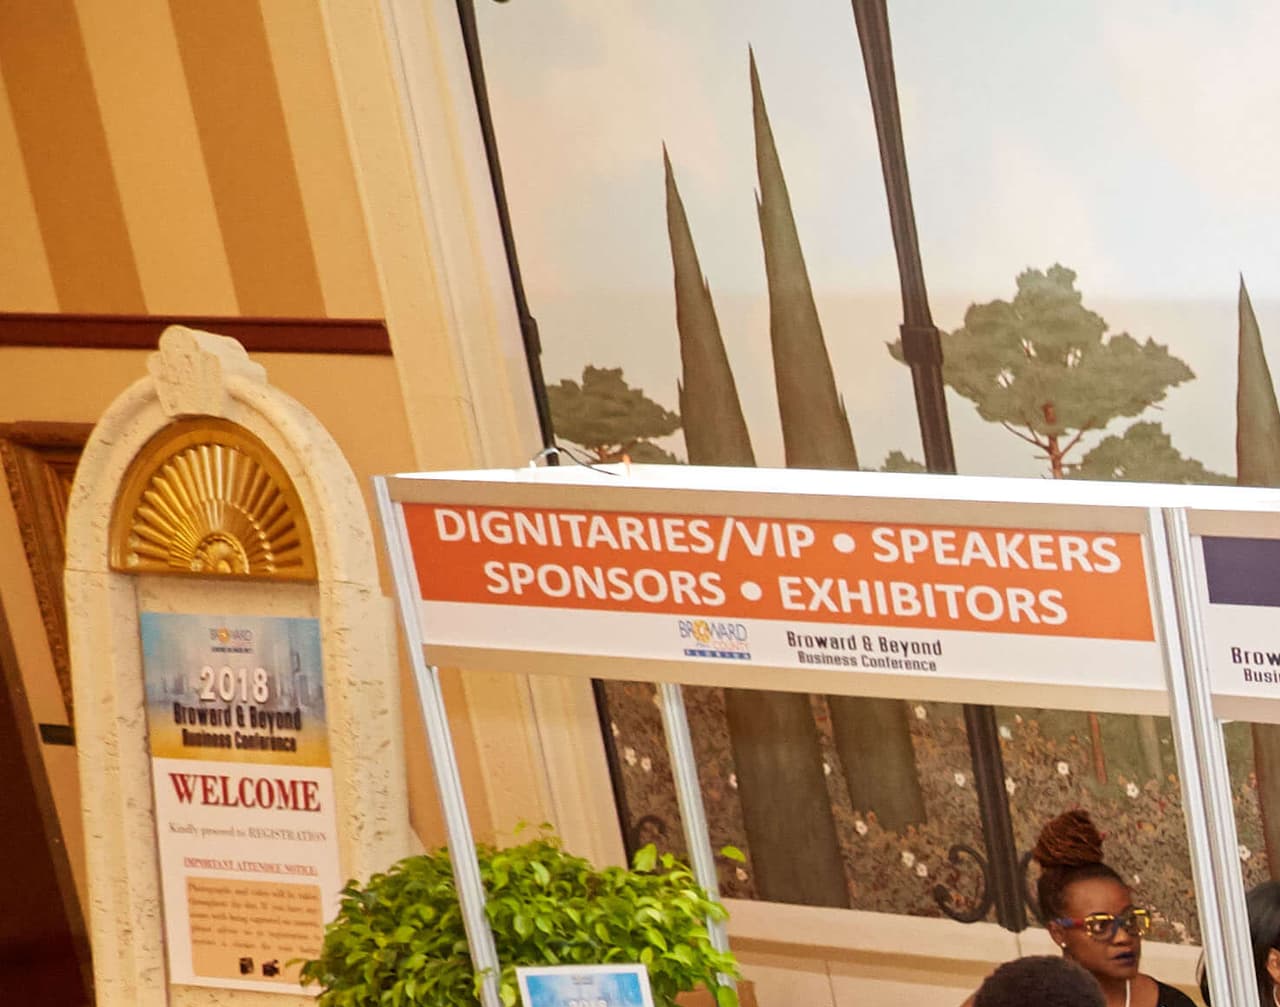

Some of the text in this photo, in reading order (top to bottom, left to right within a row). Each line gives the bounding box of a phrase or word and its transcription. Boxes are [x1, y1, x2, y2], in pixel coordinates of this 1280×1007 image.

[434, 508, 815, 562] DIGNITARIES/VIP
[872, 527, 1121, 574] SPEAKERS
[484, 561, 726, 606] SPONSORS
[778, 576, 1068, 625] EXHIBITORS
[786, 631, 942, 657] Broward & Beyond
[798, 651, 937, 672] Business Conference
[200, 666, 269, 704] 2018
[174, 702, 302, 734] Broward & Beyond
[234, 731, 297, 752] Conference
[168, 773, 321, 812] WELCOME
[248, 828, 327, 841] REGISTRATION
